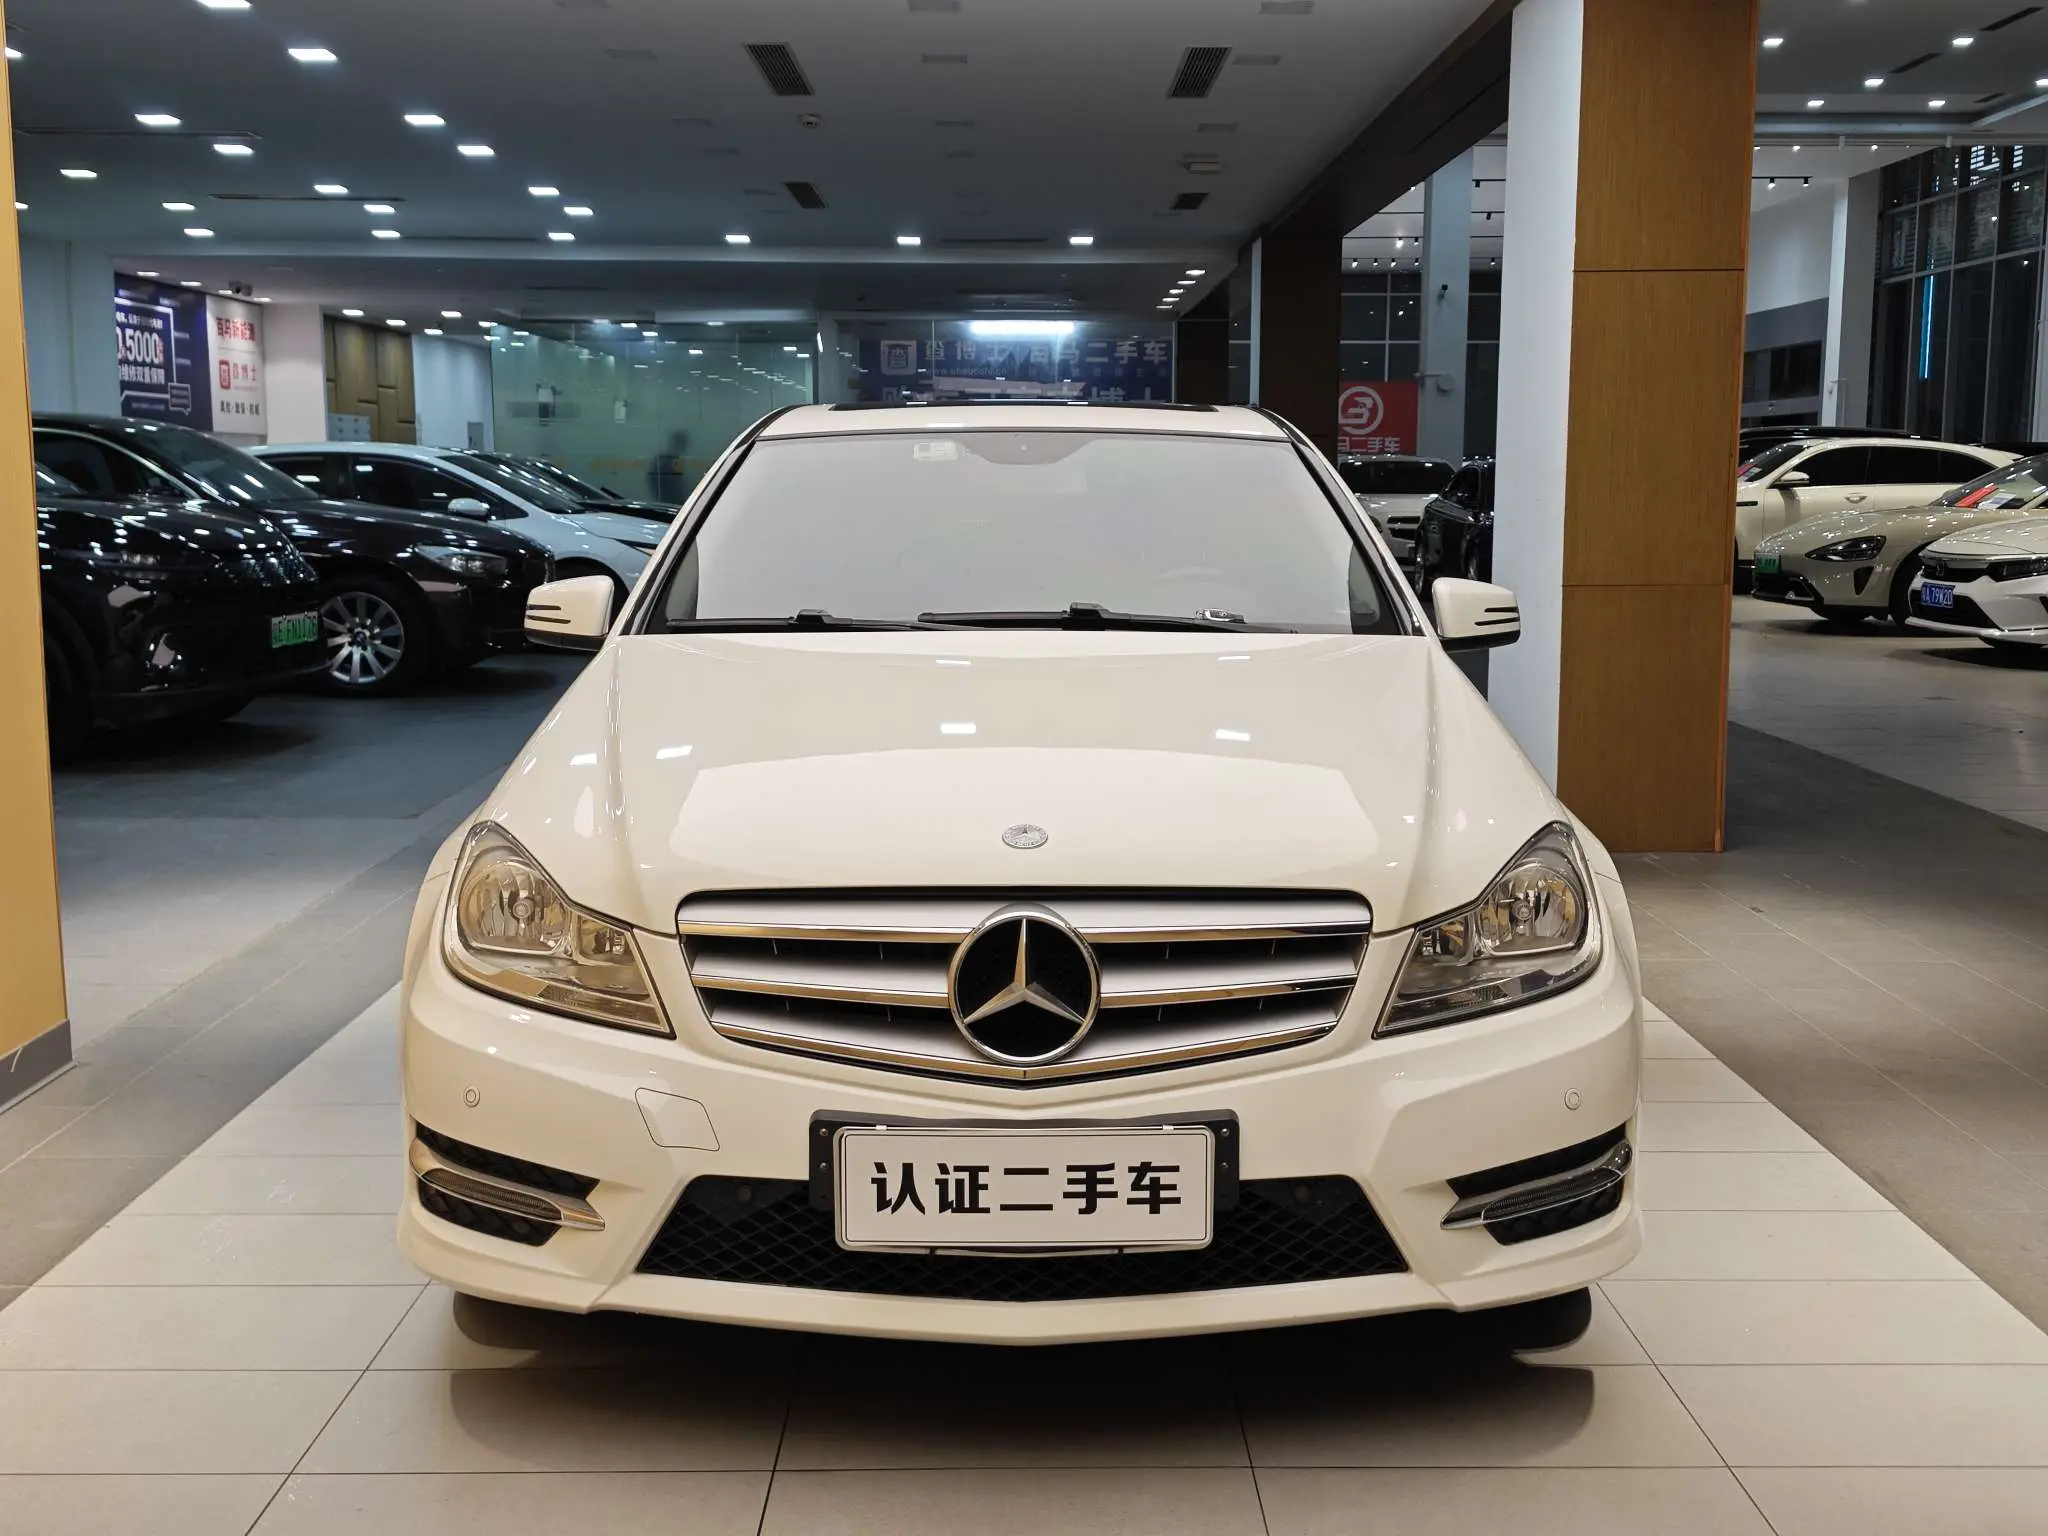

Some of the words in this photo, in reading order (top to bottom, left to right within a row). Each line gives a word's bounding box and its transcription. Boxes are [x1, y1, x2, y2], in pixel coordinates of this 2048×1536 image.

[870, 1161, 1182, 1216] 认证二手车
